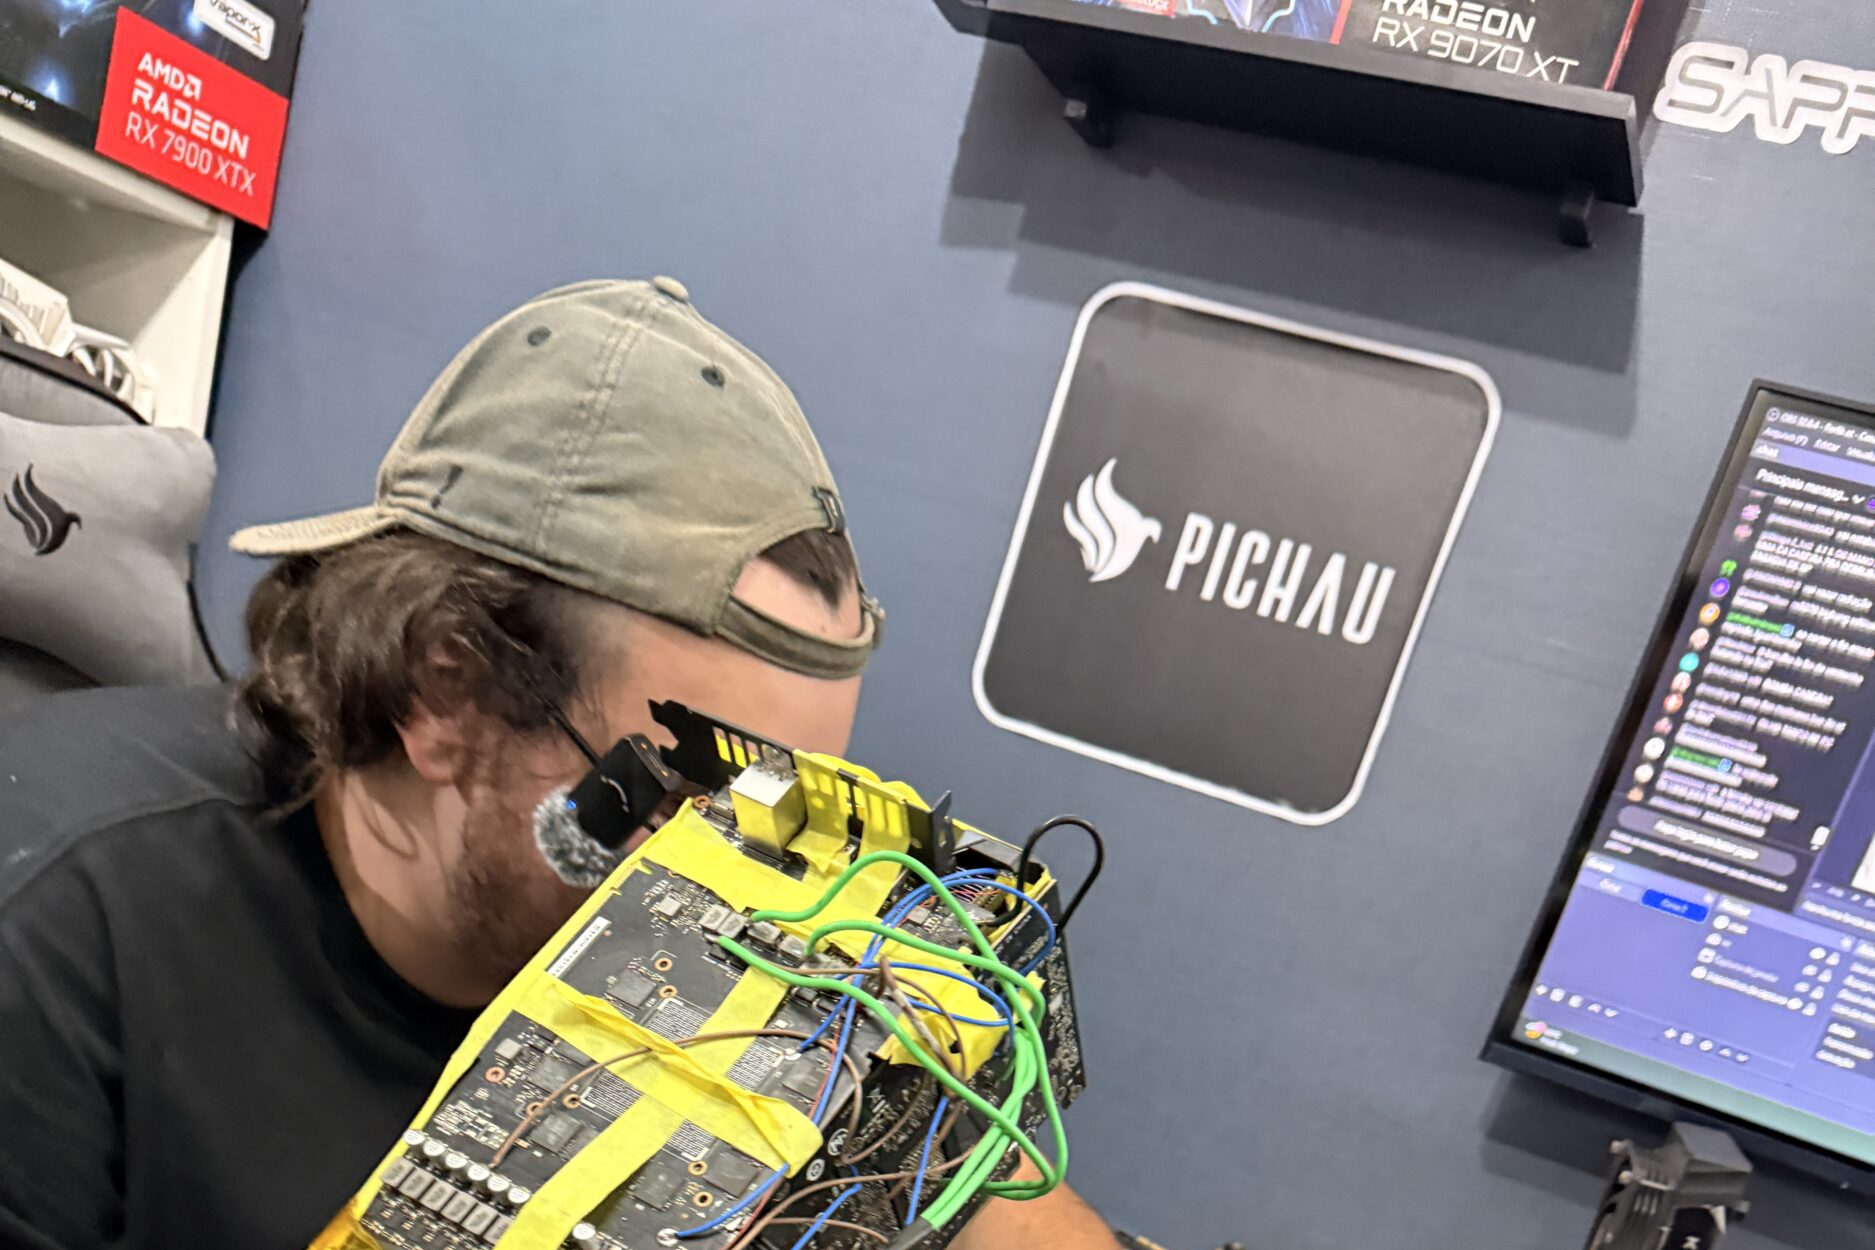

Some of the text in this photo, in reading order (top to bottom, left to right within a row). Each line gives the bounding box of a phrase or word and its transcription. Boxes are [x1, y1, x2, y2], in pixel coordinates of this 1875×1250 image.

[137, 52, 184, 97] AMD
[1371, 16, 1580, 84] RX 9070 XT
[124, 111, 257, 197] RX 7900 XTX
[130, 78, 251, 160] RADEON
[1165, 511, 1397, 645] PICHAU
